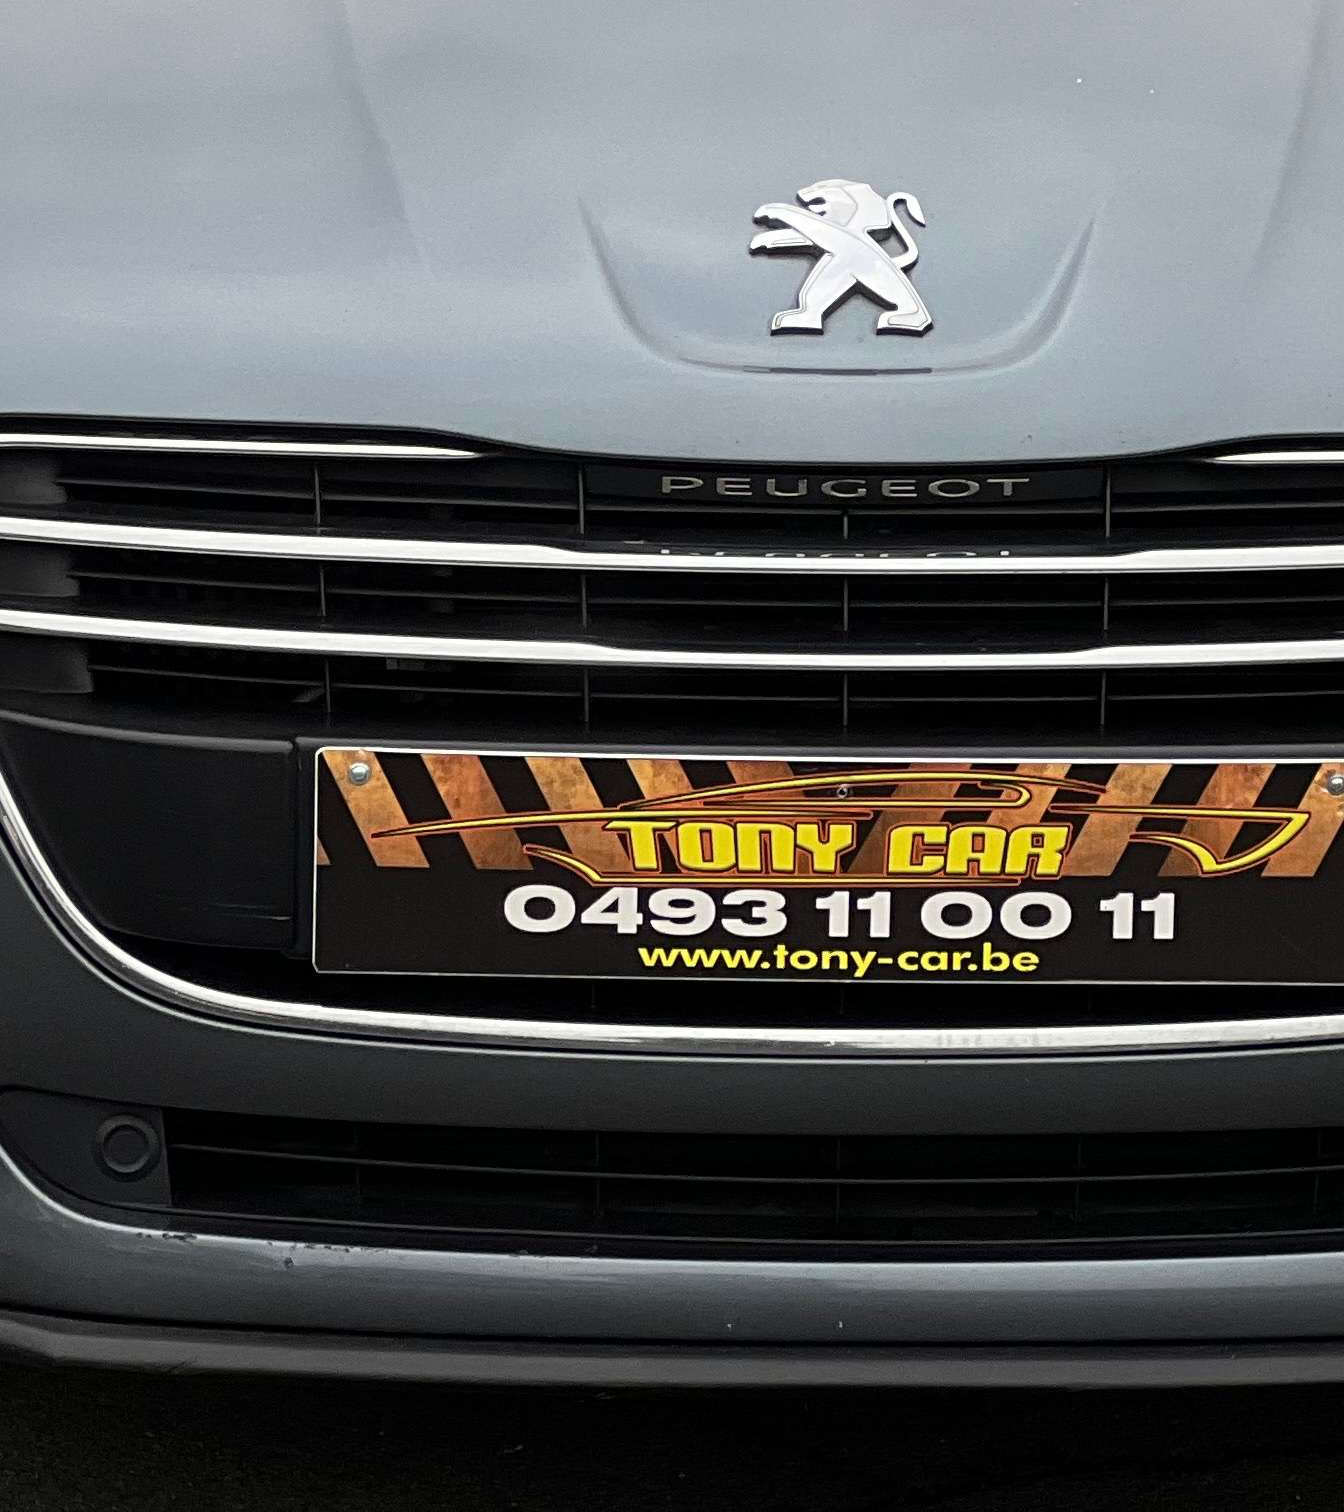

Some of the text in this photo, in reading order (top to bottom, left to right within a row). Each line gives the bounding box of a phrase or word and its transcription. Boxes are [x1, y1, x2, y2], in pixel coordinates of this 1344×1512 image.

[661, 475, 1031, 499] PEUGEOT
[604, 819, 1070, 876] TONY CAR
[503, 884, 1176, 941] 0493 11 00 11
[637, 941, 1041, 978] www.tony-car.be
